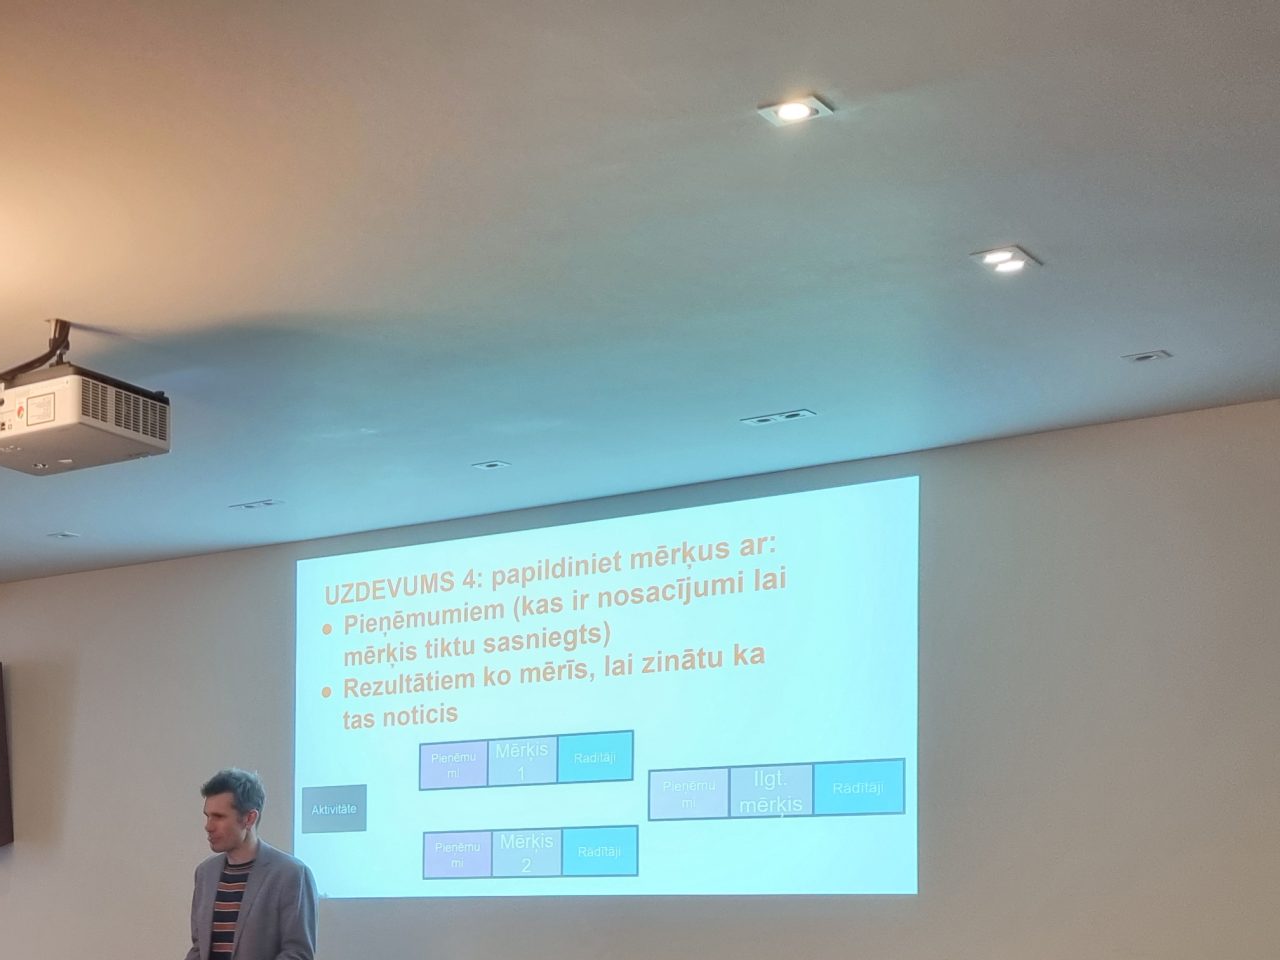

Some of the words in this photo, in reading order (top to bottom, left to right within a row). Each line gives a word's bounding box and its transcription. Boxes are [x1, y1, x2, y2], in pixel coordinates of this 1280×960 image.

[325, 571, 455, 606] UZDEVUMS
[462, 569, 483, 589] 4:
[492, 550, 622, 592] papildiniet
[630, 541, 730, 570] mērķus
[740, 535, 776, 557] ar:
[344, 602, 505, 637] Pieņēmumiem
[513, 595, 563, 622] (kas
[572, 589, 589, 611] ir
[598, 570, 744, 608] nosacījumi
[754, 566, 786, 591] lai
[344, 641, 417, 668] mērķis
[425, 636, 475, 659] tiktu
[483, 620, 611, 654] sasniegts)
[344, 670, 475, 699] Rezultātiem
[483, 666, 512, 687] ko
[520, 659, 595, 684] mērīs,
[604, 653, 633, 677] lai
[642, 648, 723, 674] zinātu
[733, 643, 765, 666] ka
[343, 710, 375, 730] tas
[383, 702, 458, 728] noticis
[495, 742, 549, 761] Mērķis
[518, 767, 524, 780] 1
[739, 795, 803, 818] mērķis
[500, 834, 554, 853] Mērķis
[521, 859, 531, 873] 2
